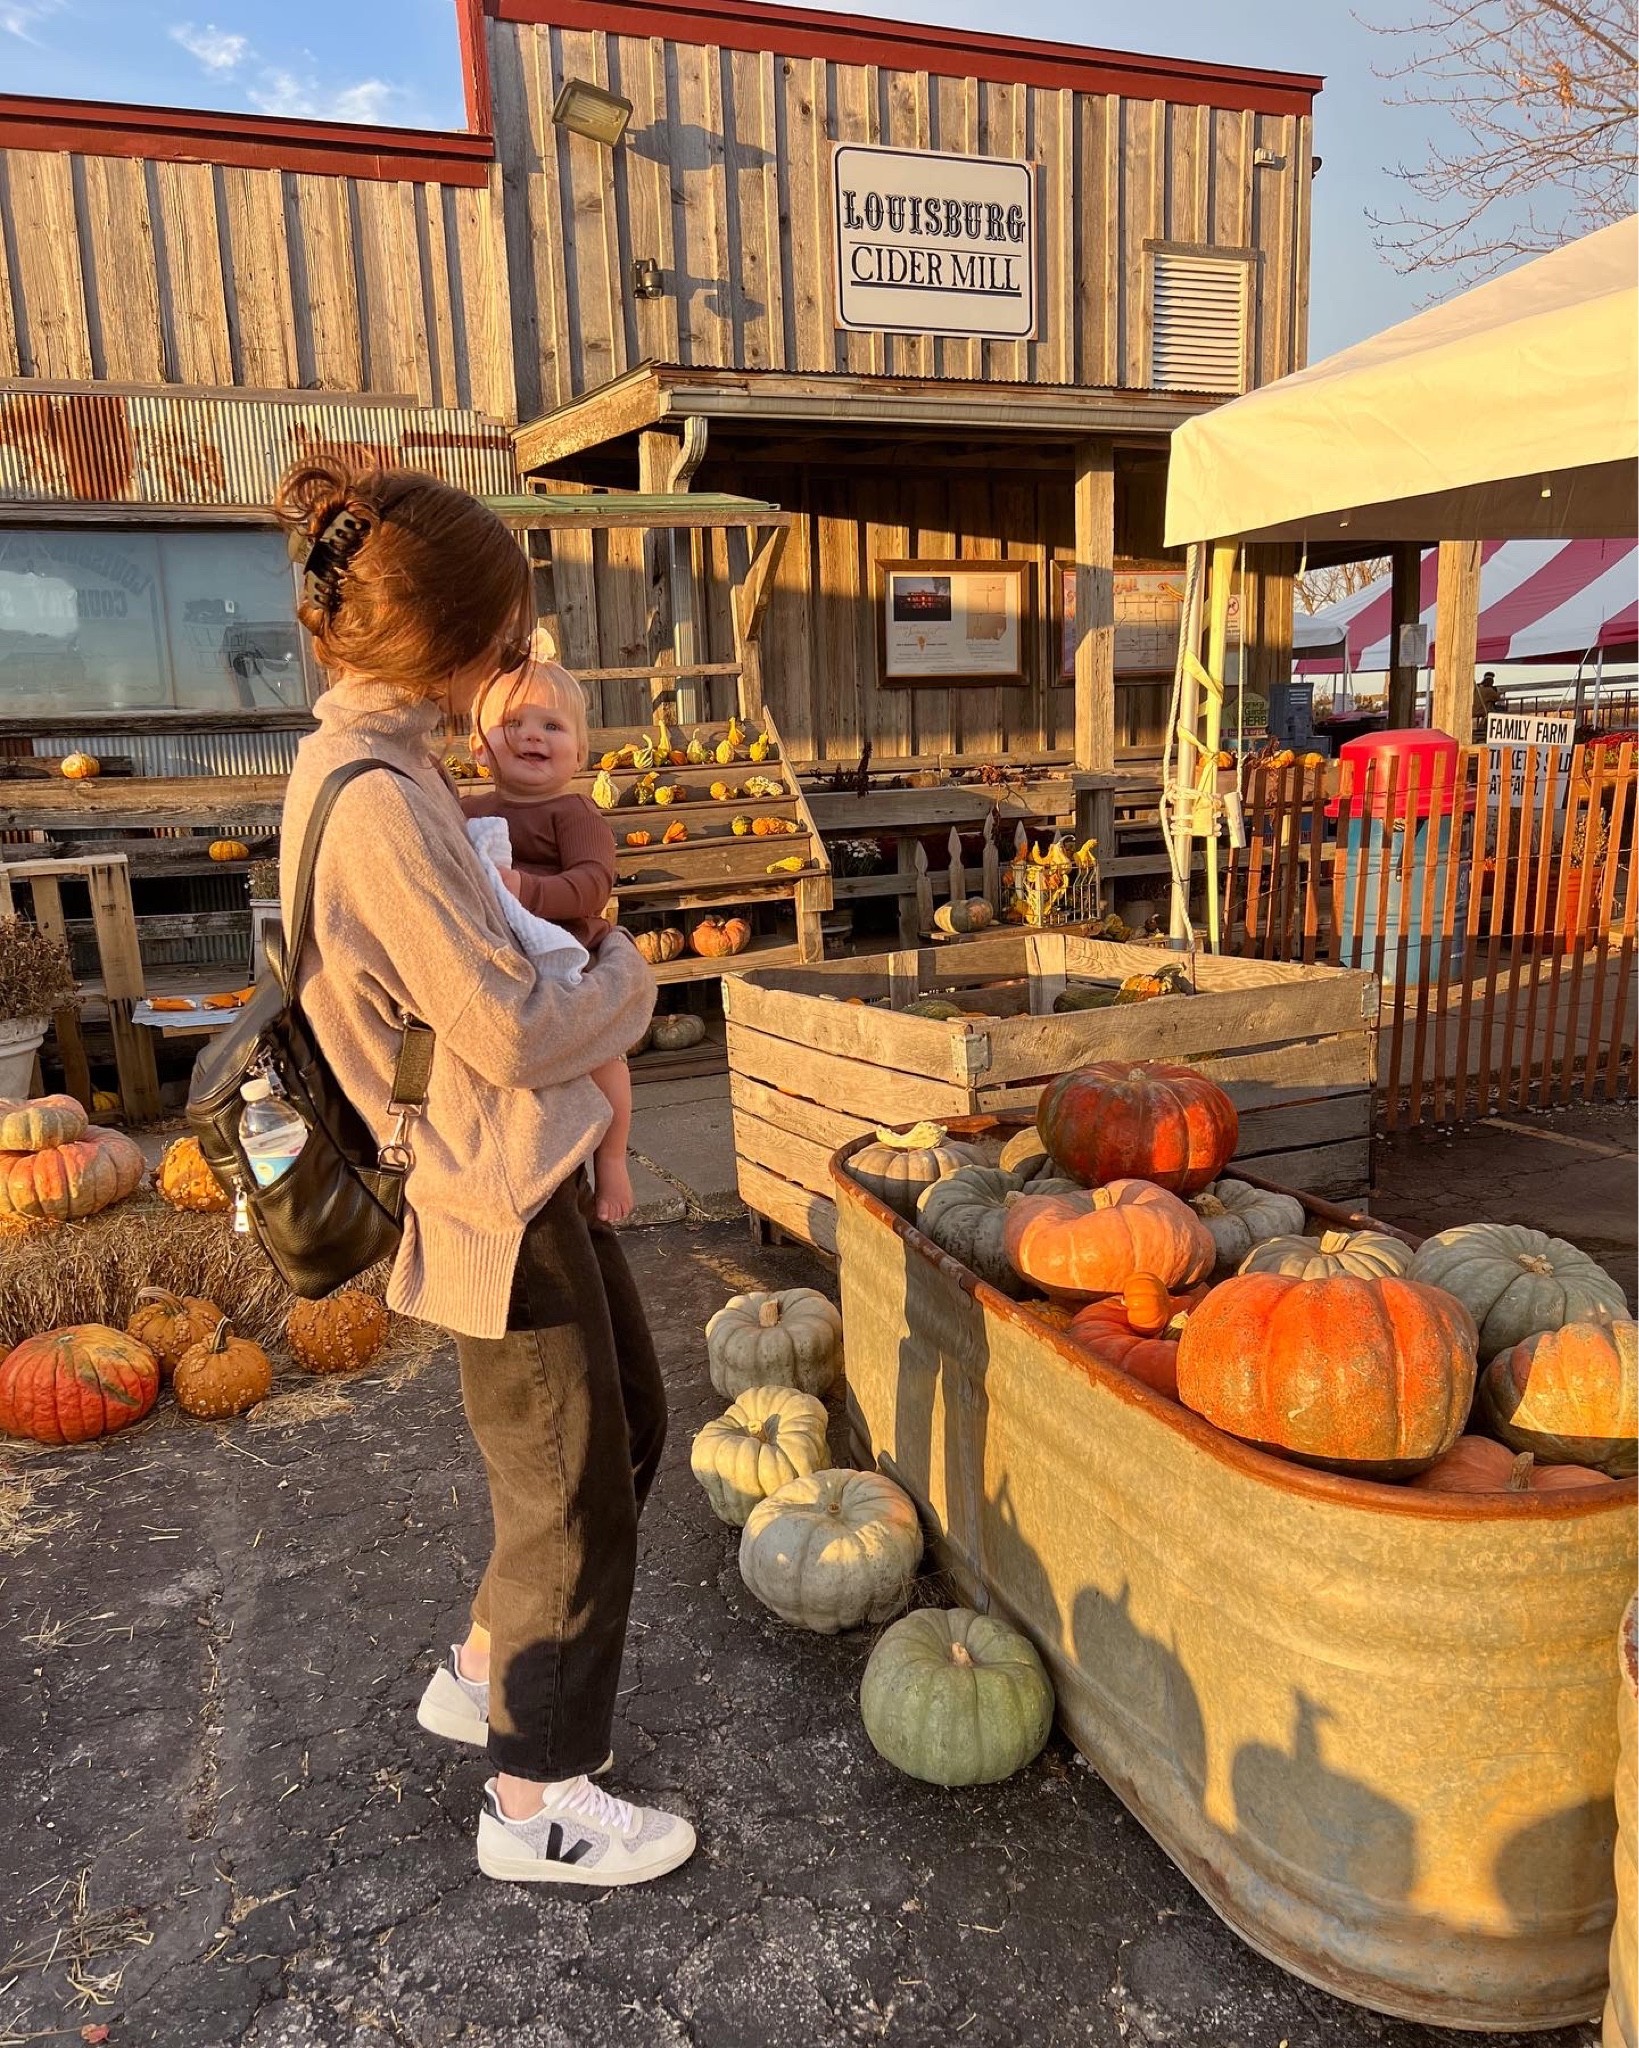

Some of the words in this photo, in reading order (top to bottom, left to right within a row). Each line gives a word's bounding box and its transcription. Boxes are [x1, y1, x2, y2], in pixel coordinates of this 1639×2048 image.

[843, 189, 1026, 243] LOUISBURG
[851, 246, 942, 286] CIDER
[951, 253, 1020, 291] MILL
[1489, 718, 1531, 741] FAMILY
[1536, 722, 1568, 744] FARM
